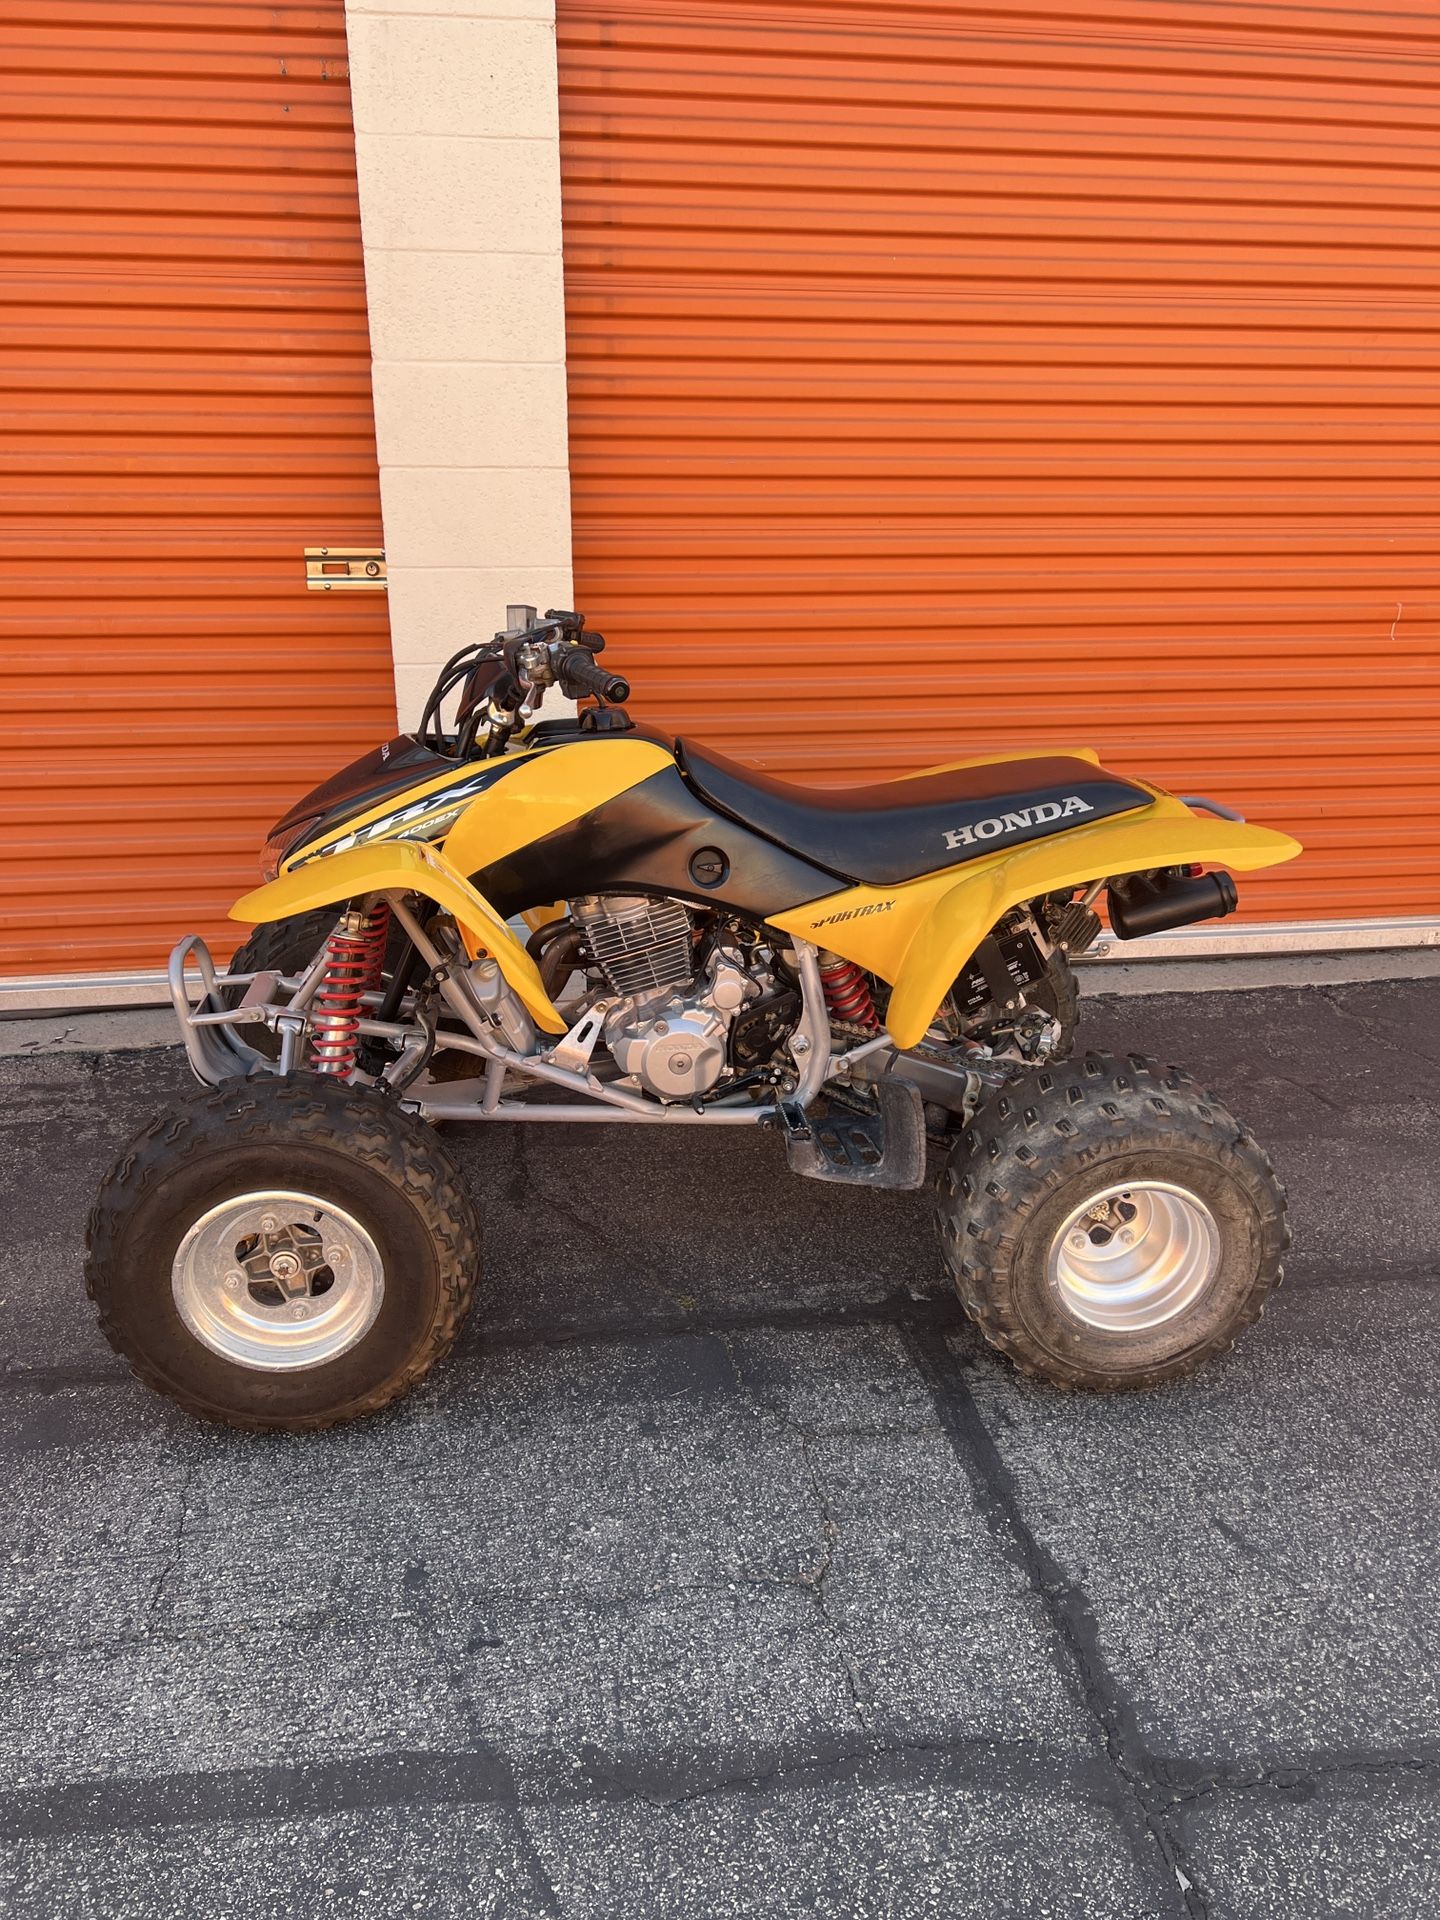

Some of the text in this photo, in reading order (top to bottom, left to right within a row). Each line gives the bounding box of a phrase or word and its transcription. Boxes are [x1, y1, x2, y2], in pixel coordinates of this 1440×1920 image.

[397, 808, 459, 840] 400EX
[941, 796, 1094, 850] HONDA
[809, 899, 897, 930] SPORTRAX
